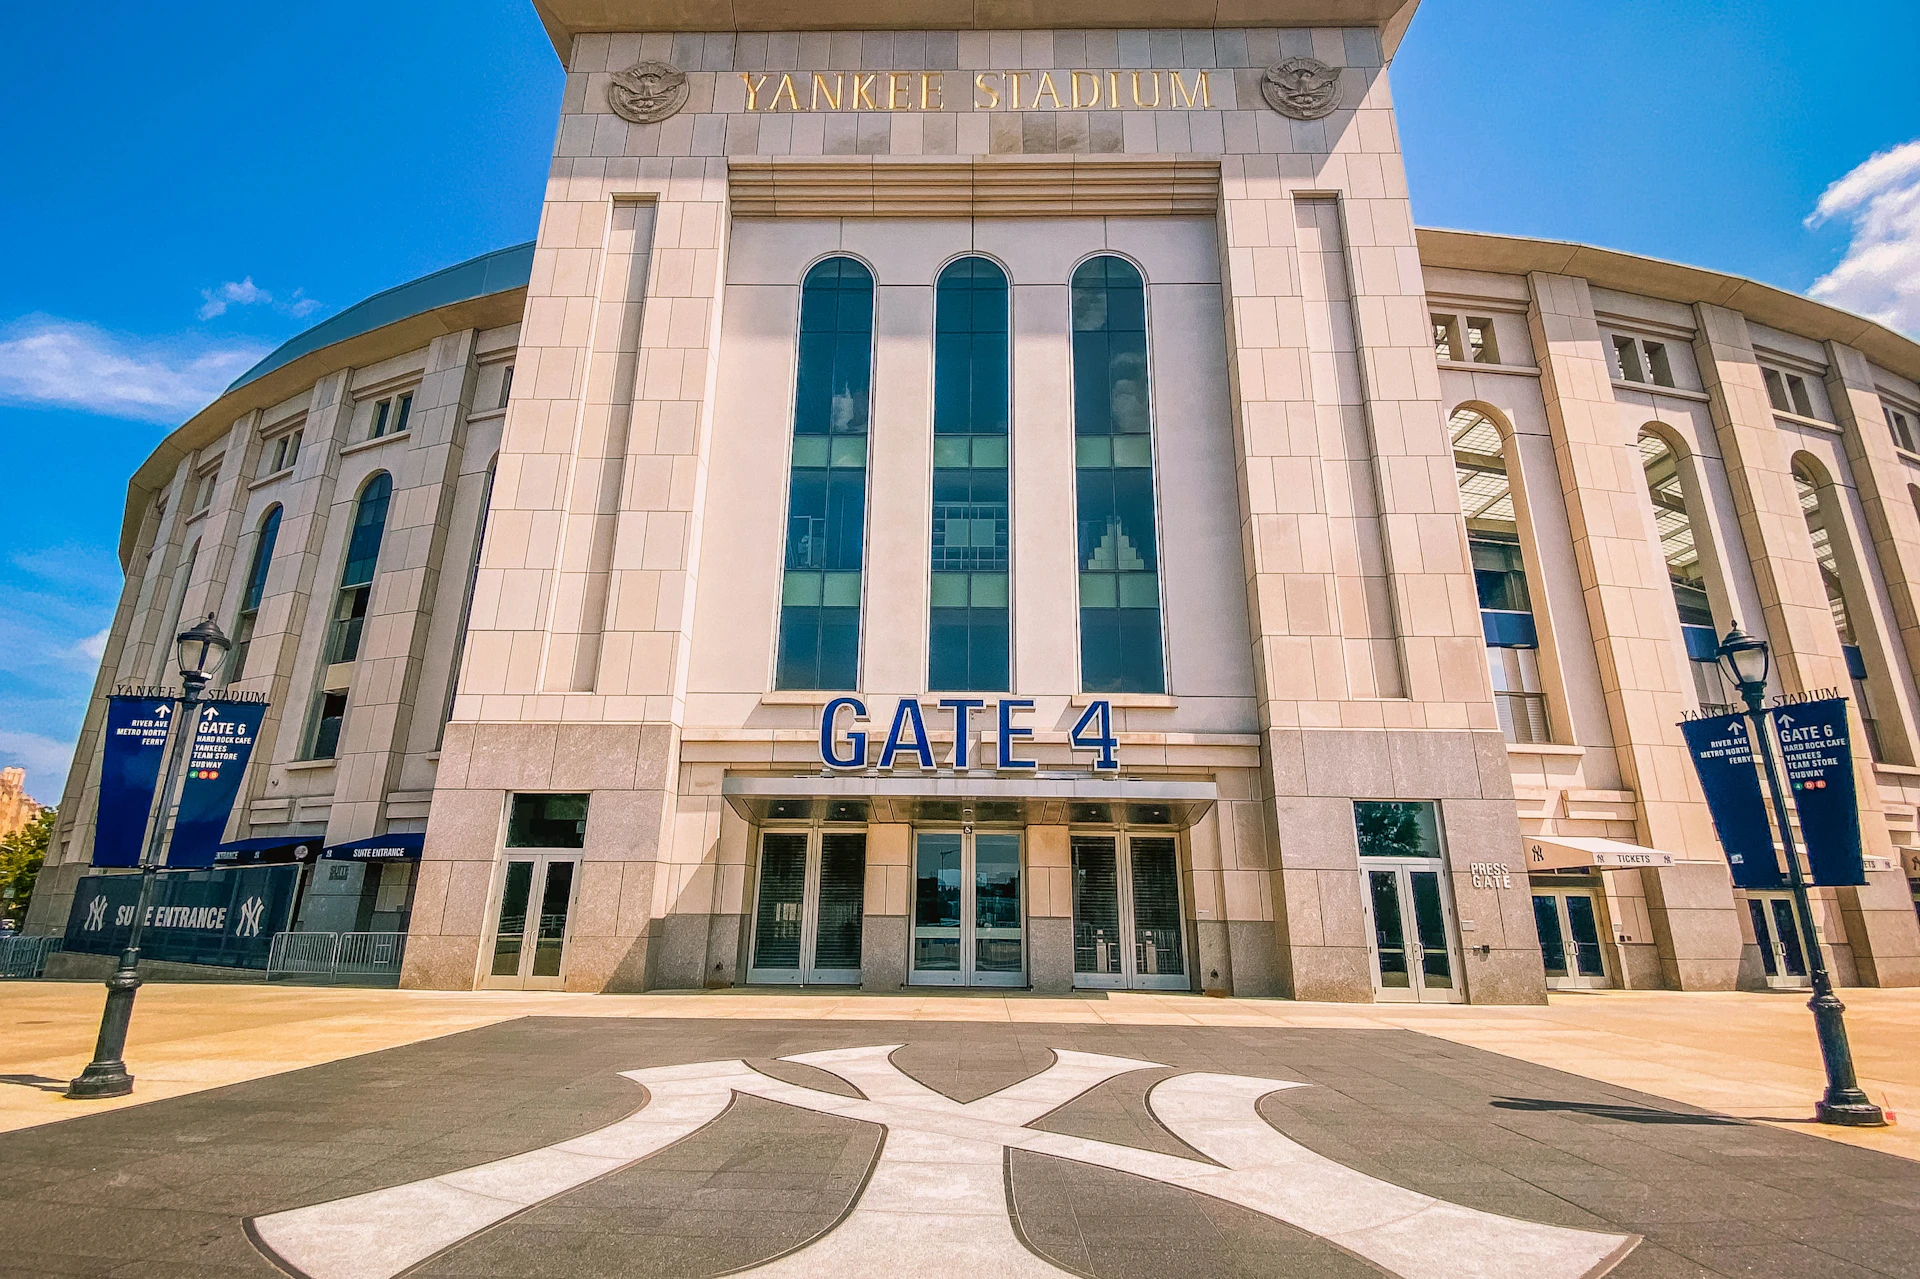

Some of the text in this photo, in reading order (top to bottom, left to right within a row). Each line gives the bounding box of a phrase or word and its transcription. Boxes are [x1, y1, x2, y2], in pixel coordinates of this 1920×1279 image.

[738, 70, 1215, 111] YANKEE STADIUM
[117, 685, 266, 703] YANKEE STADIUM
[1772, 687, 1840, 707] STADIUM
[131, 719, 169, 728] RIVER AVE
[199, 721, 246, 735] GATE 6
[116, 728, 167, 737] METRO NORTH
[819, 696, 1121, 773] GATE 4
[1780, 724, 1833, 743] GATE 6
[141, 737, 165, 746] FERRY
[196, 735, 252, 745] HARD ROCK CAFE
[1710, 736, 1748, 748] RIVER AVE
[1783, 738, 1846, 752] HARD ROCK CAFE
[194, 744, 228, 753] YANKEES
[1700, 746, 1750, 759] METRO NORTH
[193, 751, 238, 760] TEAM STORE
[1729, 755, 1751, 765] FERRY
[1785, 751, 1822, 762] YANKEES
[190, 760, 222, 769] SUBWAY
[1787, 758, 1838, 770] TEAM STORE
[1790, 769, 1824, 779] SUBWAY
[353, 847, 405, 858] SUITE ENTRANCE
[1616, 854, 1651, 864] TICKETS
[1470, 862, 1509, 876] PRESS
[1472, 874, 1512, 889] GATE
[115, 904, 154, 927] SUE
[154, 906, 227, 929] ENTRANCE
